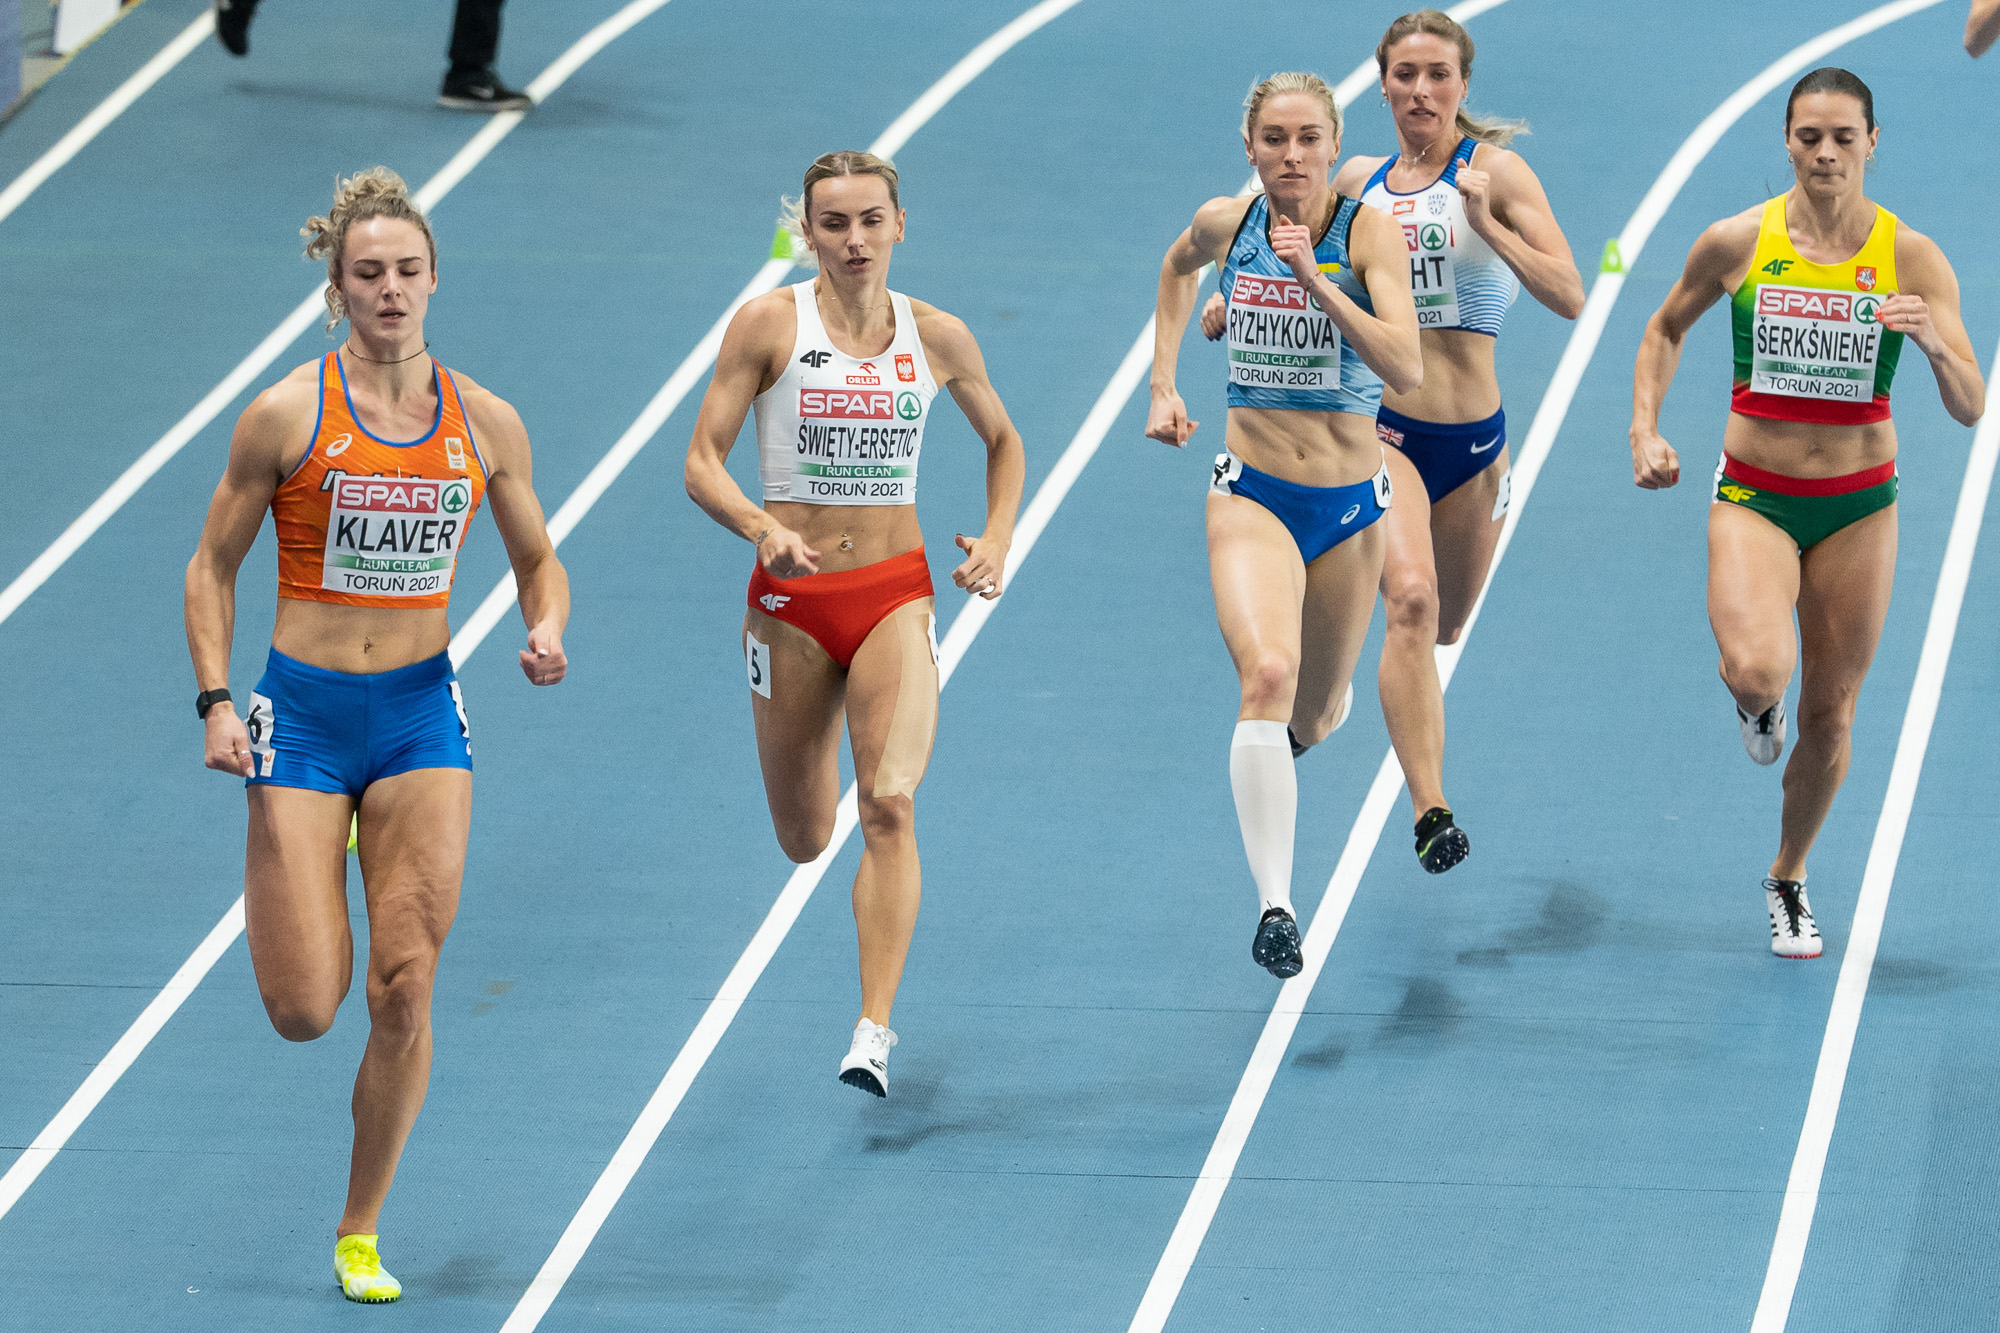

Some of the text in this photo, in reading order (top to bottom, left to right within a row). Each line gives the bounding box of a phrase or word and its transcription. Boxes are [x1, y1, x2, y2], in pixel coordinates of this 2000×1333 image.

[1762, 259, 1794, 276] 4F
[1234, 279, 1304, 306] SPAR
[1762, 292, 1848, 318] SPAR
[1418, 311, 1443, 324] 021
[1230, 308, 1335, 349] RYZHYKOVA
[800, 350, 832, 368] 4F
[1245, 353, 1269, 363] RUN
[1271, 355, 1309, 366] CLEAN
[1235, 366, 1323, 385] TORUŃ 2021
[1784, 363, 1808, 374] RUN
[1810, 365, 1848, 377] CLEAN
[847, 376, 879, 385] ORLEN
[1769, 376, 1859, 397] TORUŃ 2021
[802, 392, 892, 415] SPAR
[797, 417, 917, 466] ŚWIĘTY-ERSETIC
[826, 466, 852, 476] RUN
[854, 467, 892, 477] CLEAN
[340, 483, 436, 509] SPAR
[808, 481, 903, 496] TORUŃ 2021
[335, 515, 457, 553] KLAVER
[362, 559, 390, 571] RUN
[392, 561, 430, 571] CLEAN
[343, 573, 440, 592] TORUŃ 2021
[759, 593, 791, 612] 4F
[751, 646, 762, 686] 5
[247, 703, 262, 745] 6
